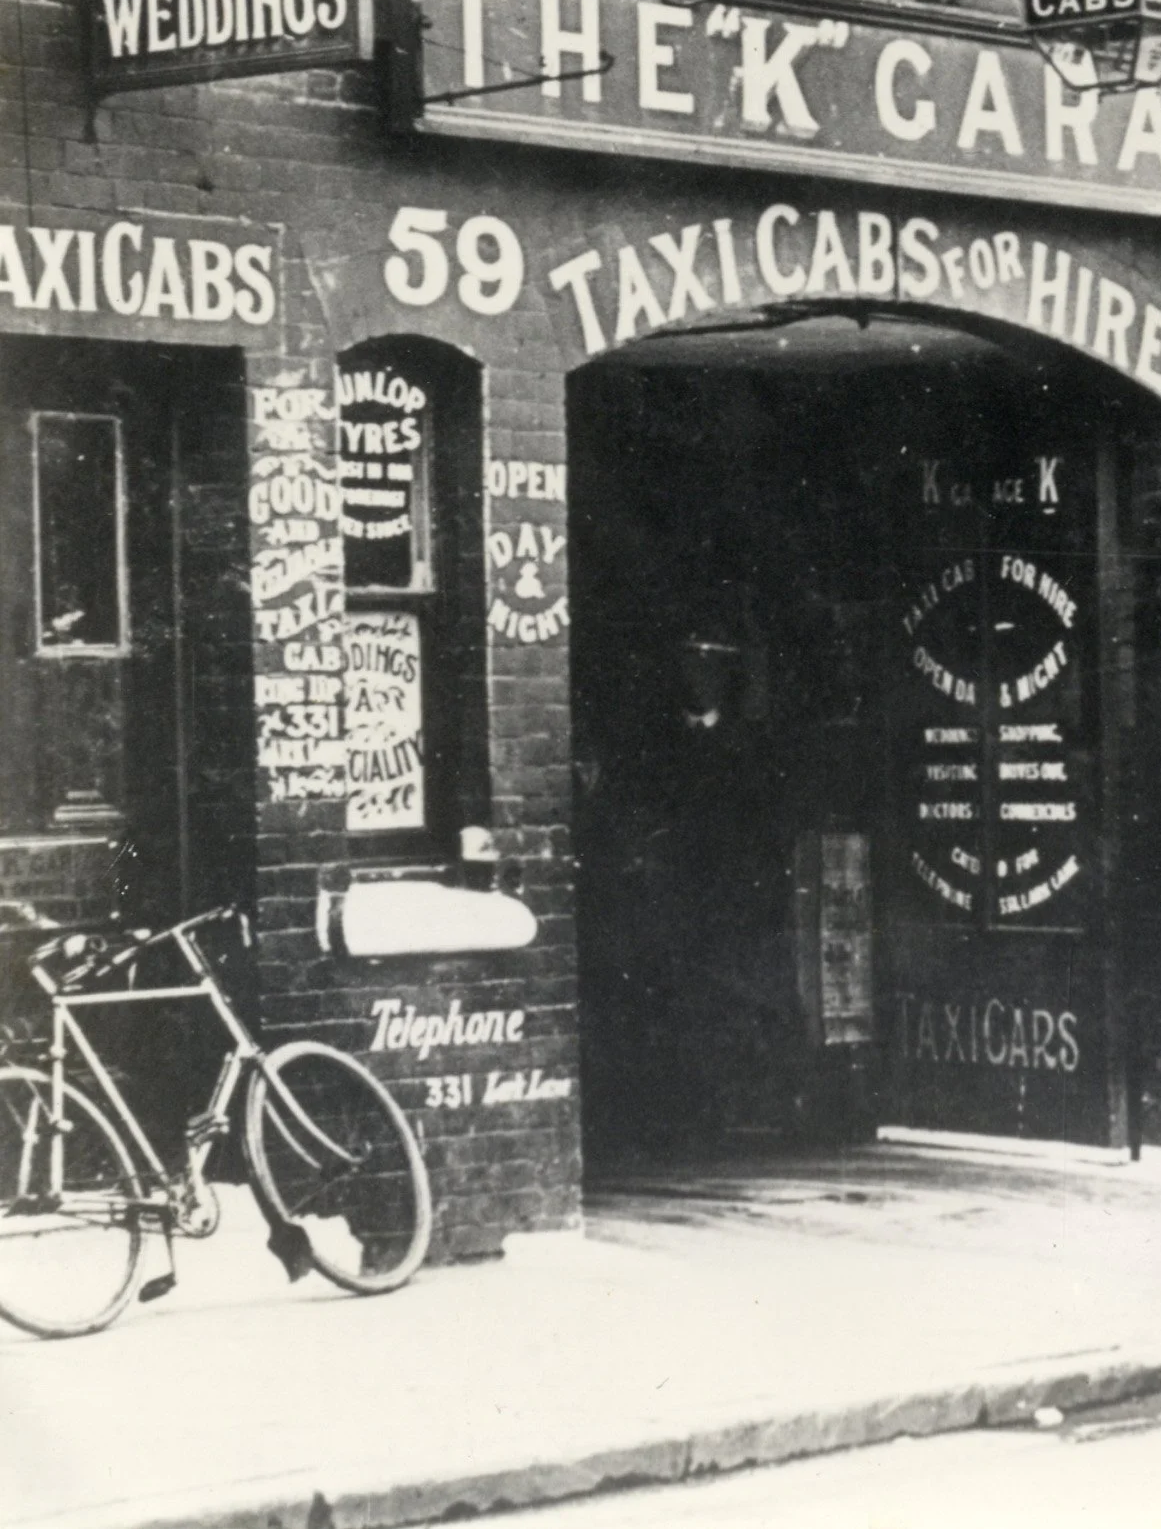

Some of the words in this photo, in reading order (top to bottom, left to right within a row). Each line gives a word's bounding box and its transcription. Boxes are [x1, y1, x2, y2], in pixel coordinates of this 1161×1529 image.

[0, 222, 275, 325] AXICABS
[384, 207, 525, 316] 59
[940, 231, 1025, 300] FOR
[337, 370, 426, 413] UNLOP
[249, 474, 343, 524] GOOD
[488, 460, 567, 501] OPEN
[1034, 455, 1064, 504] K
[489, 522, 567, 568] DAY
[515, 562, 546, 599] &
[1001, 554, 1037, 591] FOR
[487, 595, 571, 643] NIGHT
[285, 642, 342, 671] CAB
[347, 642, 418, 684] DINGS
[913, 645, 955, 697] OPEN
[286, 705, 339, 738] 331
[369, 999, 524, 1061] Telephone
[424, 1073, 473, 1109] 331
